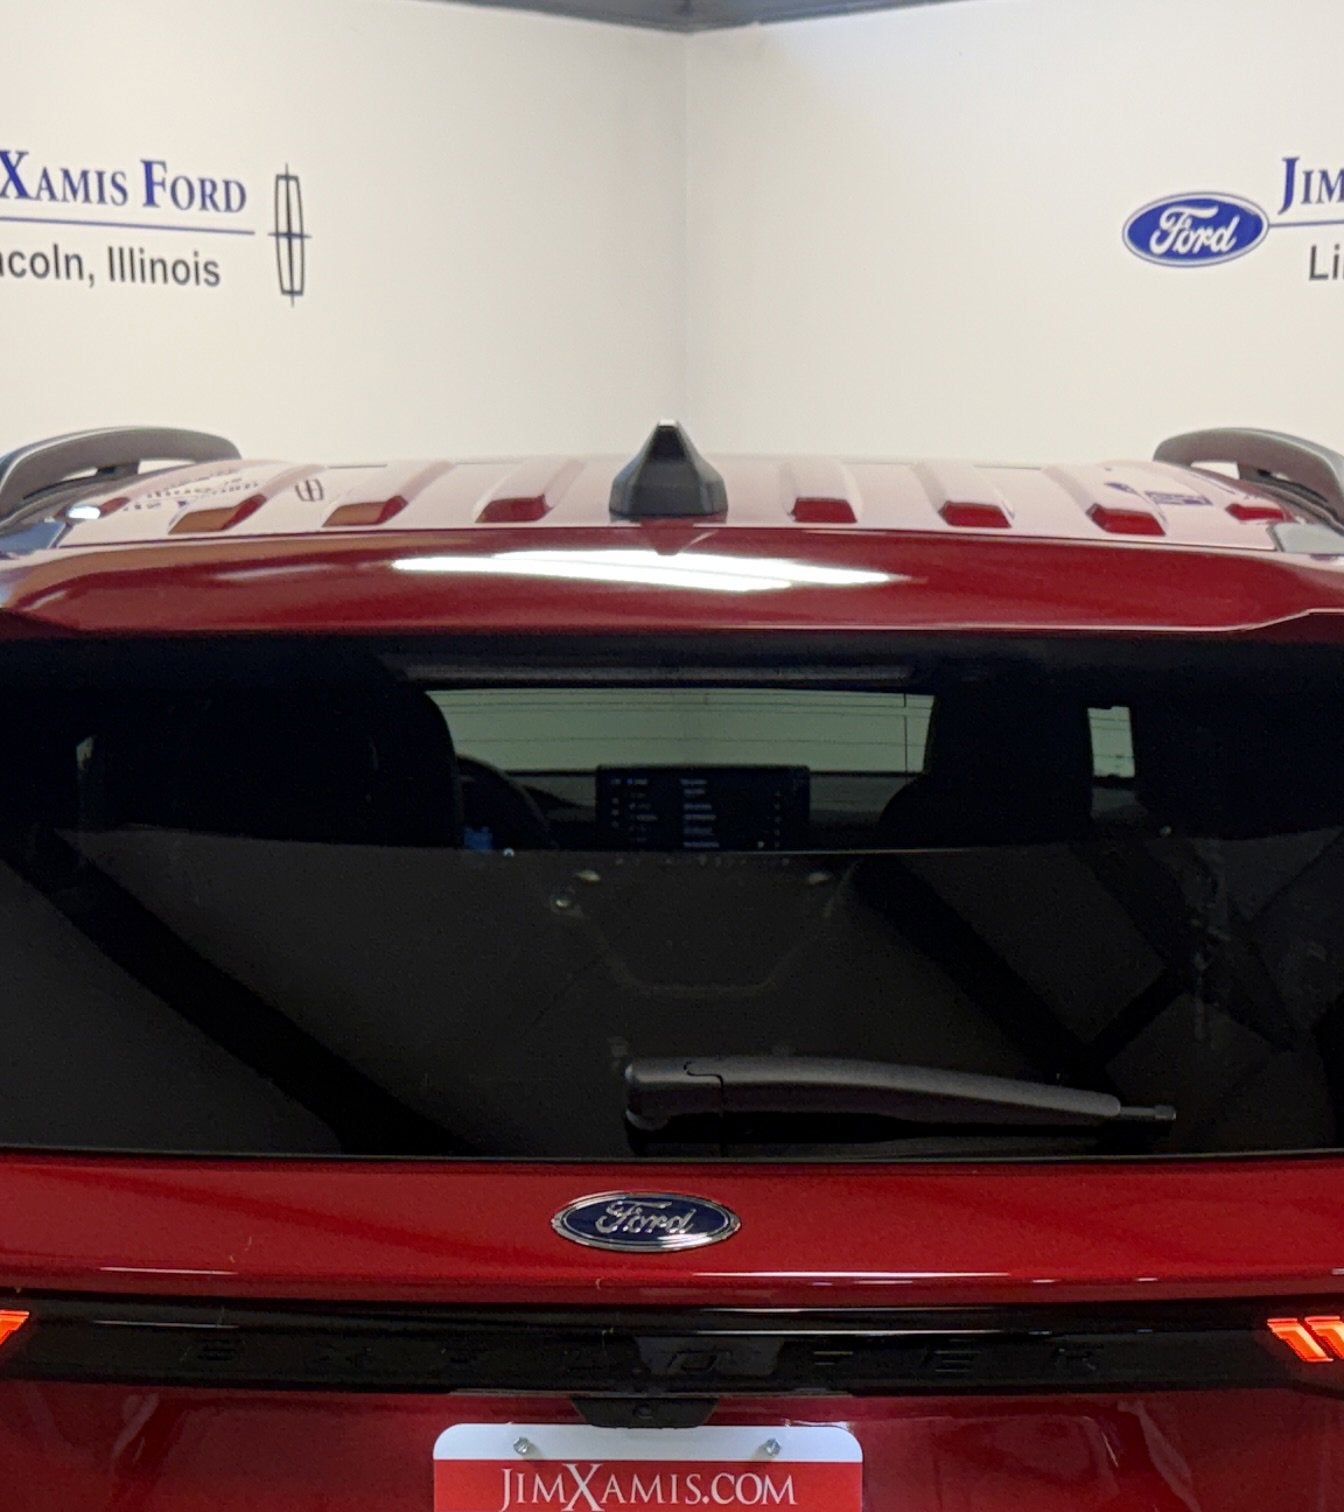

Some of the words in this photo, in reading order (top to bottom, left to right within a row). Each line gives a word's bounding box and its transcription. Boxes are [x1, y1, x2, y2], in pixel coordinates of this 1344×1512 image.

[141, 160, 247, 213] FORD
[1150, 203, 1237, 255] Ford
[108, 244, 221, 287] Illinois
[594, 1199, 697, 1234] Ford
